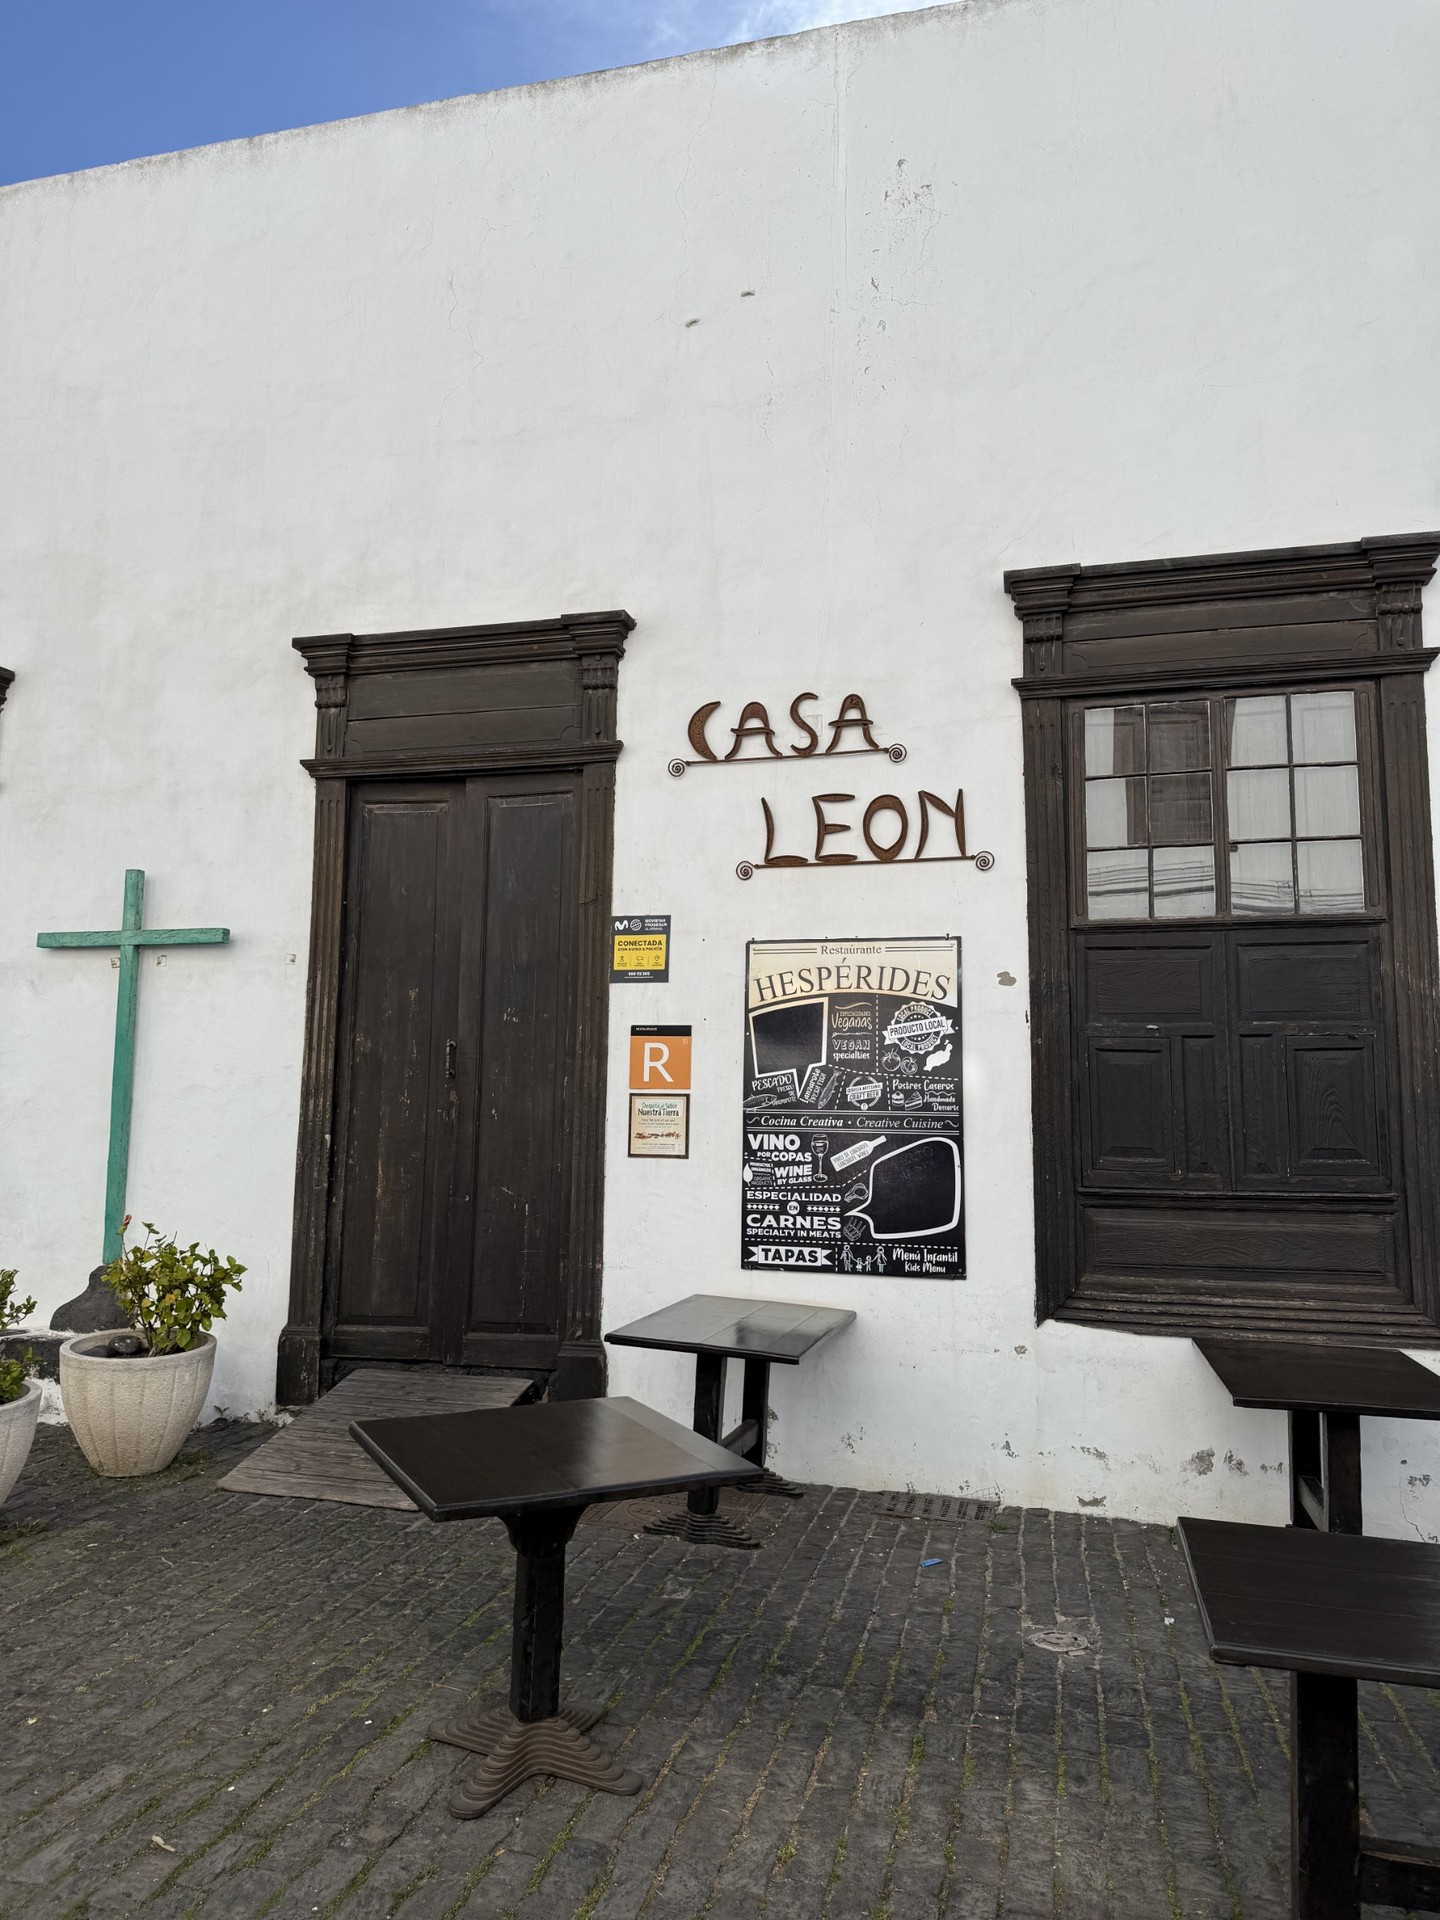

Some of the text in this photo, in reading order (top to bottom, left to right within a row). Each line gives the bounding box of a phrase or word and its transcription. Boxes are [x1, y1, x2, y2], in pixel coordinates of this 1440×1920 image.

[688, 692, 879, 759] CASA
[761, 789, 966, 864] LEON
[754, 957, 951, 1002] HESPÉRIDES
[831, 1012, 873, 1031] Veganas
[889, 1019, 945, 1036] PRODUCTO LOCAL
[832, 1039, 871, 1050] VEGAN
[644, 1042, 674, 1082] R
[833, 1051, 870, 1062] specialties
[752, 1074, 792, 1091] PESCADO
[799, 1068, 821, 1104] Lanzarote
[892, 1079, 954, 1091] Postres Caseros
[923, 1093, 956, 1103] Handmade
[638, 1107, 680, 1117] Nuestra Tierra
[932, 1103, 959, 1111] Desserts
[761, 1116, 944, 1129] Cocina Creativa Creative Cuisine
[747, 1134, 801, 1151] VINO
[771, 1151, 812, 1162] COPAS
[774, 1164, 812, 1178] WINE
[788, 1176, 812, 1184] GLASS
[746, 1191, 841, 1202] ESPECIALIDAD
[746, 1214, 841, 1230] CARNES
[746, 1228, 795, 1237] SPECIALTY
[761, 1248, 819, 1263] TAPAS
[893, 1248, 958, 1264] Menú Infantil
[905, 1261, 946, 1273] Kids Menu
